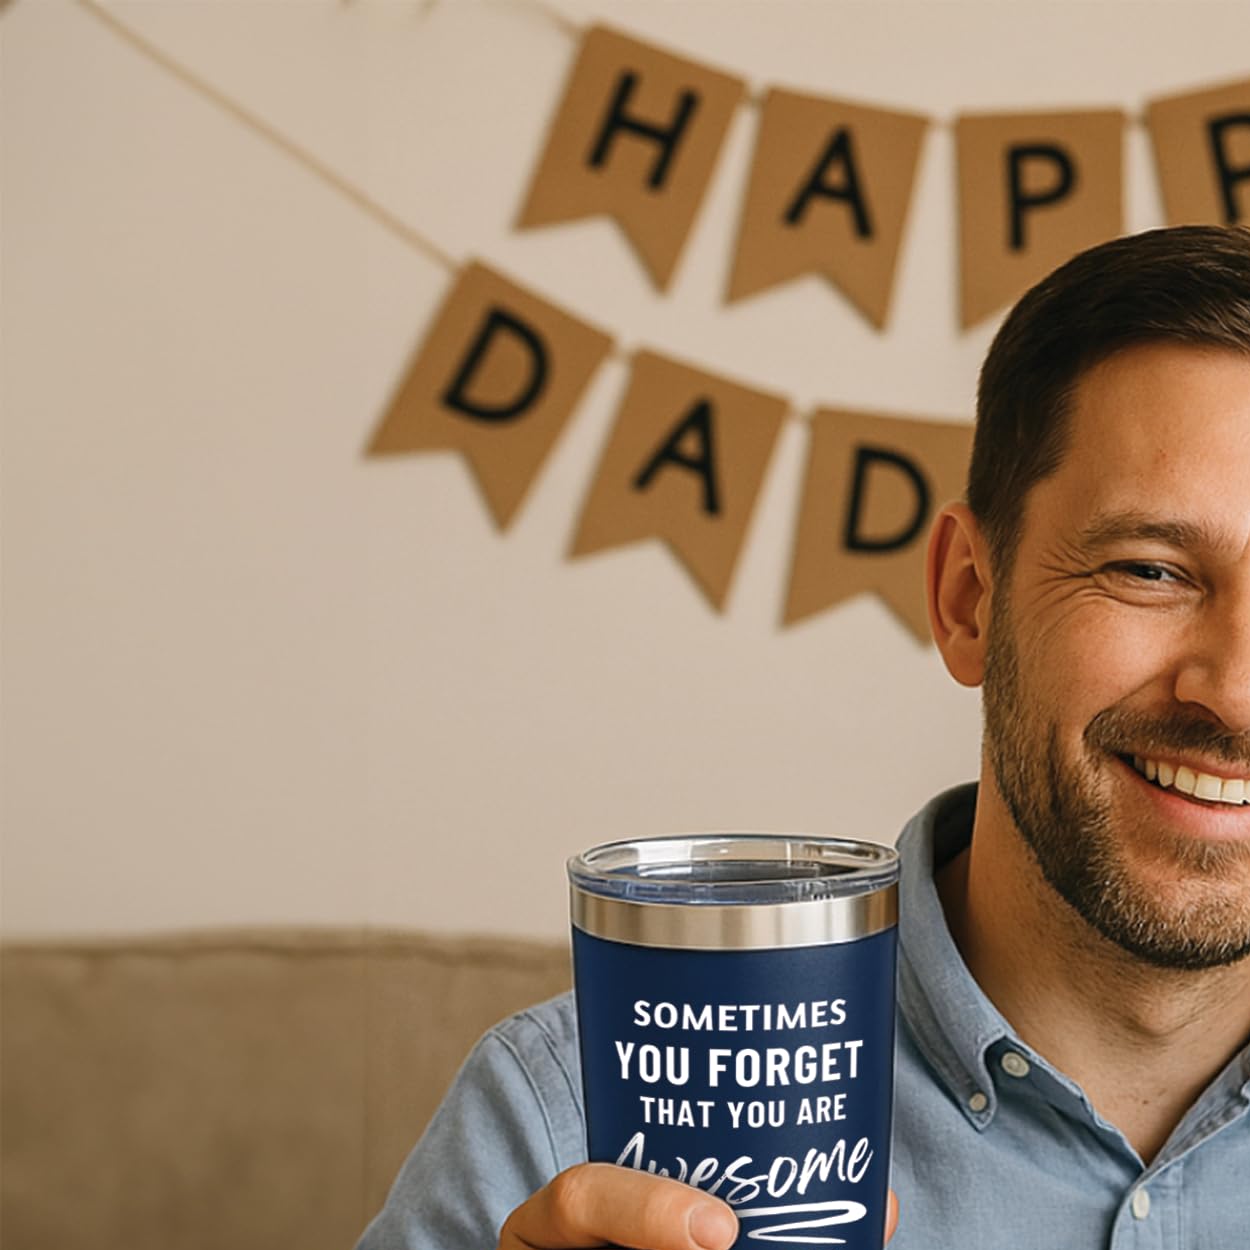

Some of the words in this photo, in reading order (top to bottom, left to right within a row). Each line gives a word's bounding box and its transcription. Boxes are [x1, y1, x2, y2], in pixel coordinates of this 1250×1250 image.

[634, 998, 847, 1032] SOMETIMES
[614, 1040, 690, 1086] YOU
[708, 1039, 864, 1088] FORGET
[640, 1095, 715, 1128] THAT
[727, 1100, 786, 1129] YOU
[796, 1093, 847, 1126] ARE
